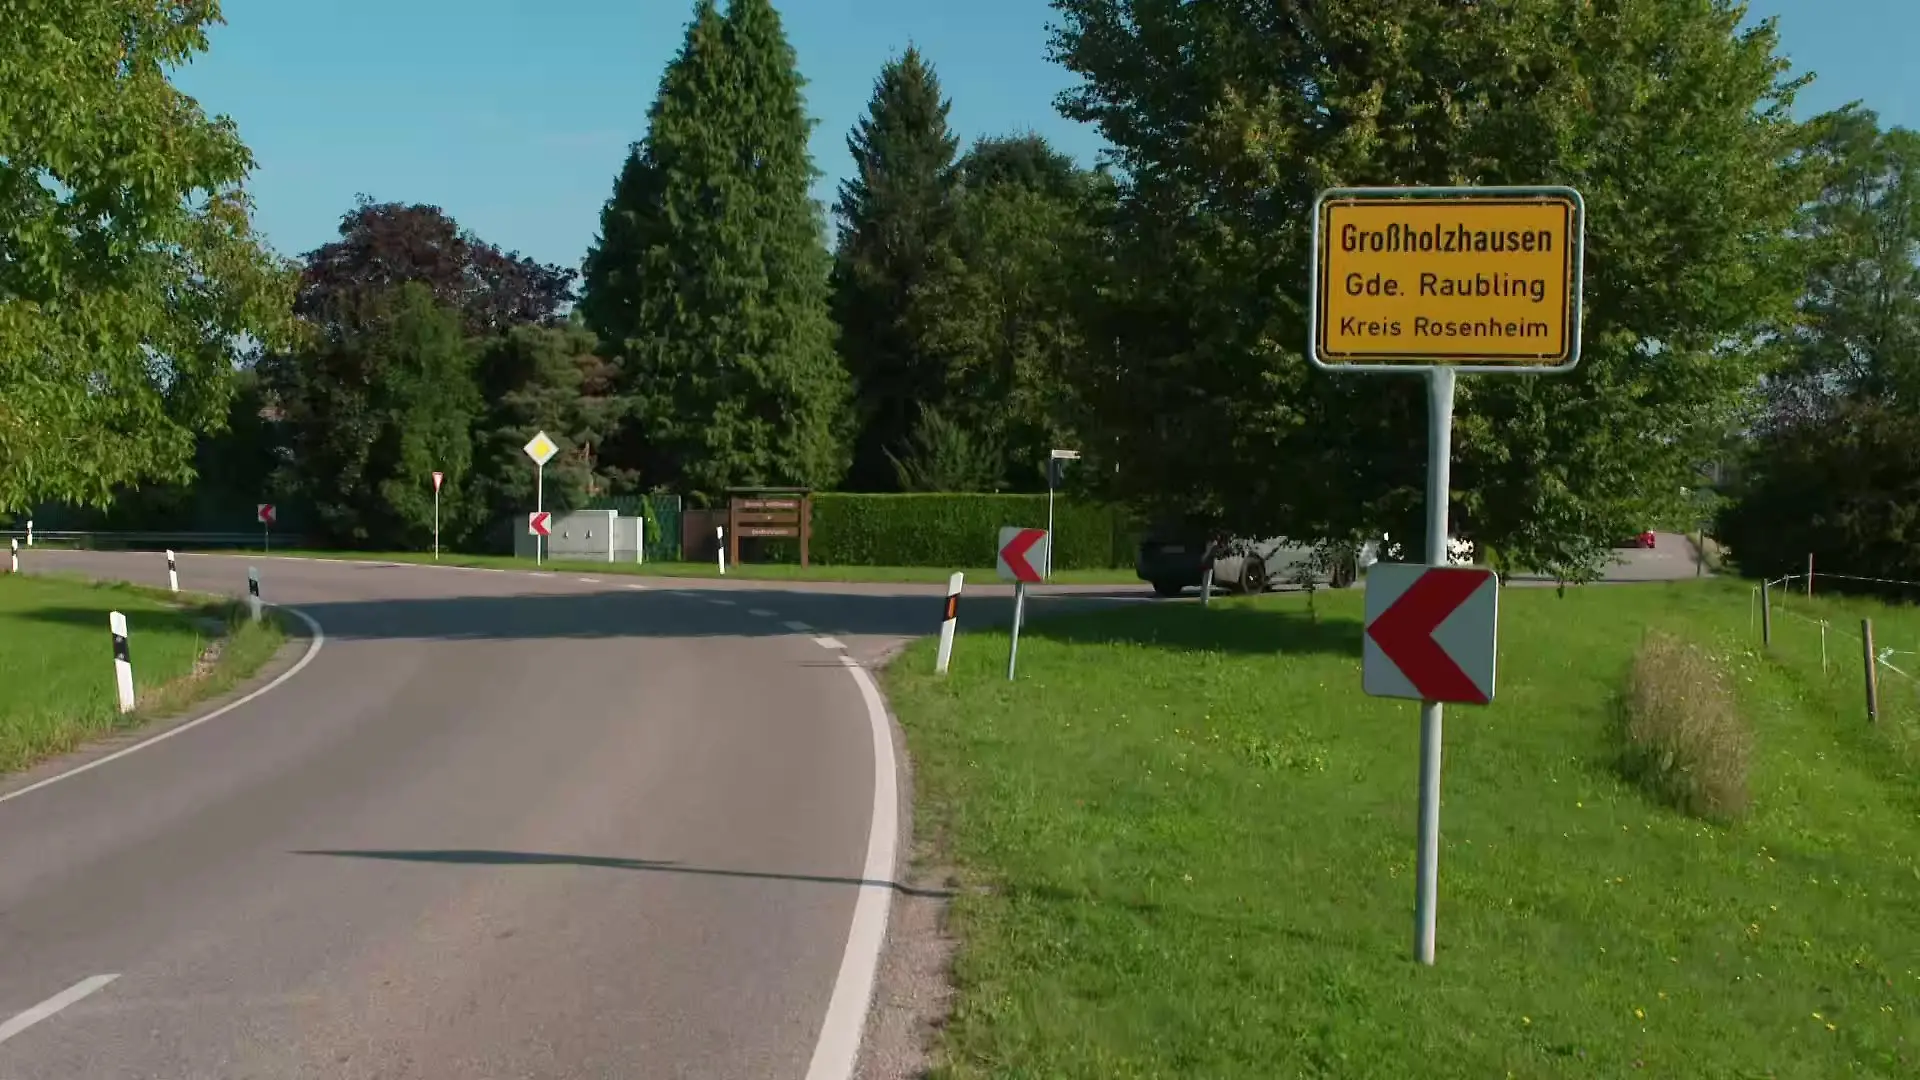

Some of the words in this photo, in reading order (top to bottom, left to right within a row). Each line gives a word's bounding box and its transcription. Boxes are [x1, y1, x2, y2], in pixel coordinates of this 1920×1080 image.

[1341, 223, 1552, 252] Großholzhausen
[1346, 272, 1404, 296] Gde.
[1420, 272, 1545, 303] Raubling
[1340, 316, 1402, 337] Kreis
[1414, 316, 1548, 337] Rosenheim
